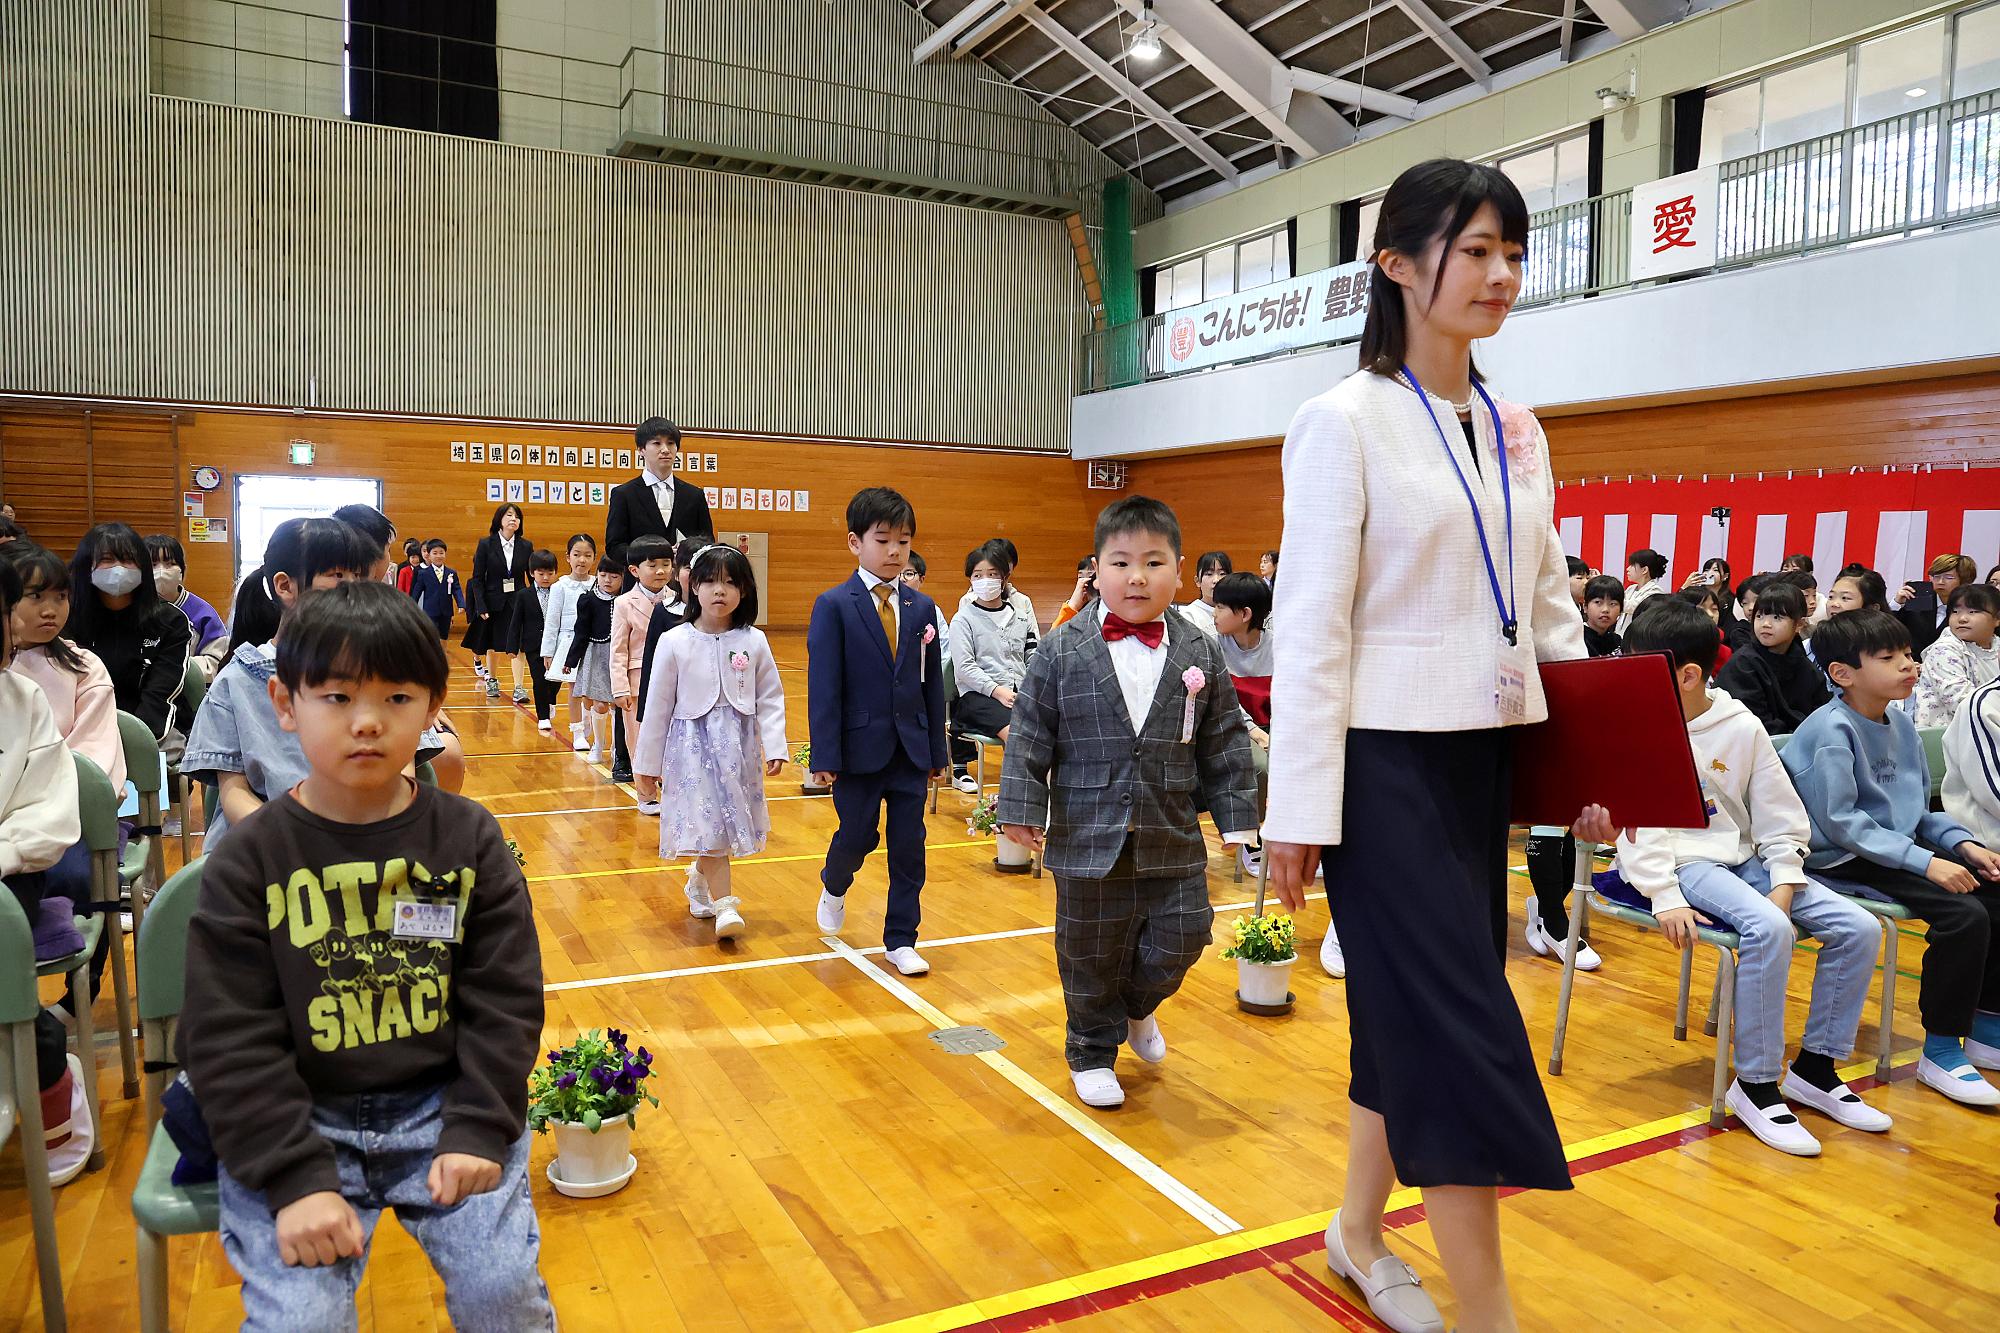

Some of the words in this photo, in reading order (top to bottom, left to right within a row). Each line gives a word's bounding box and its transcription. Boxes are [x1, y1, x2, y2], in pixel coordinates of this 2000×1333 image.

[1652, 194, 1697, 255] 愛
[1198, 286, 1313, 347] こんにちは!
[453, 445, 716, 471] 埼玉県の体力向上に向け合言葉
